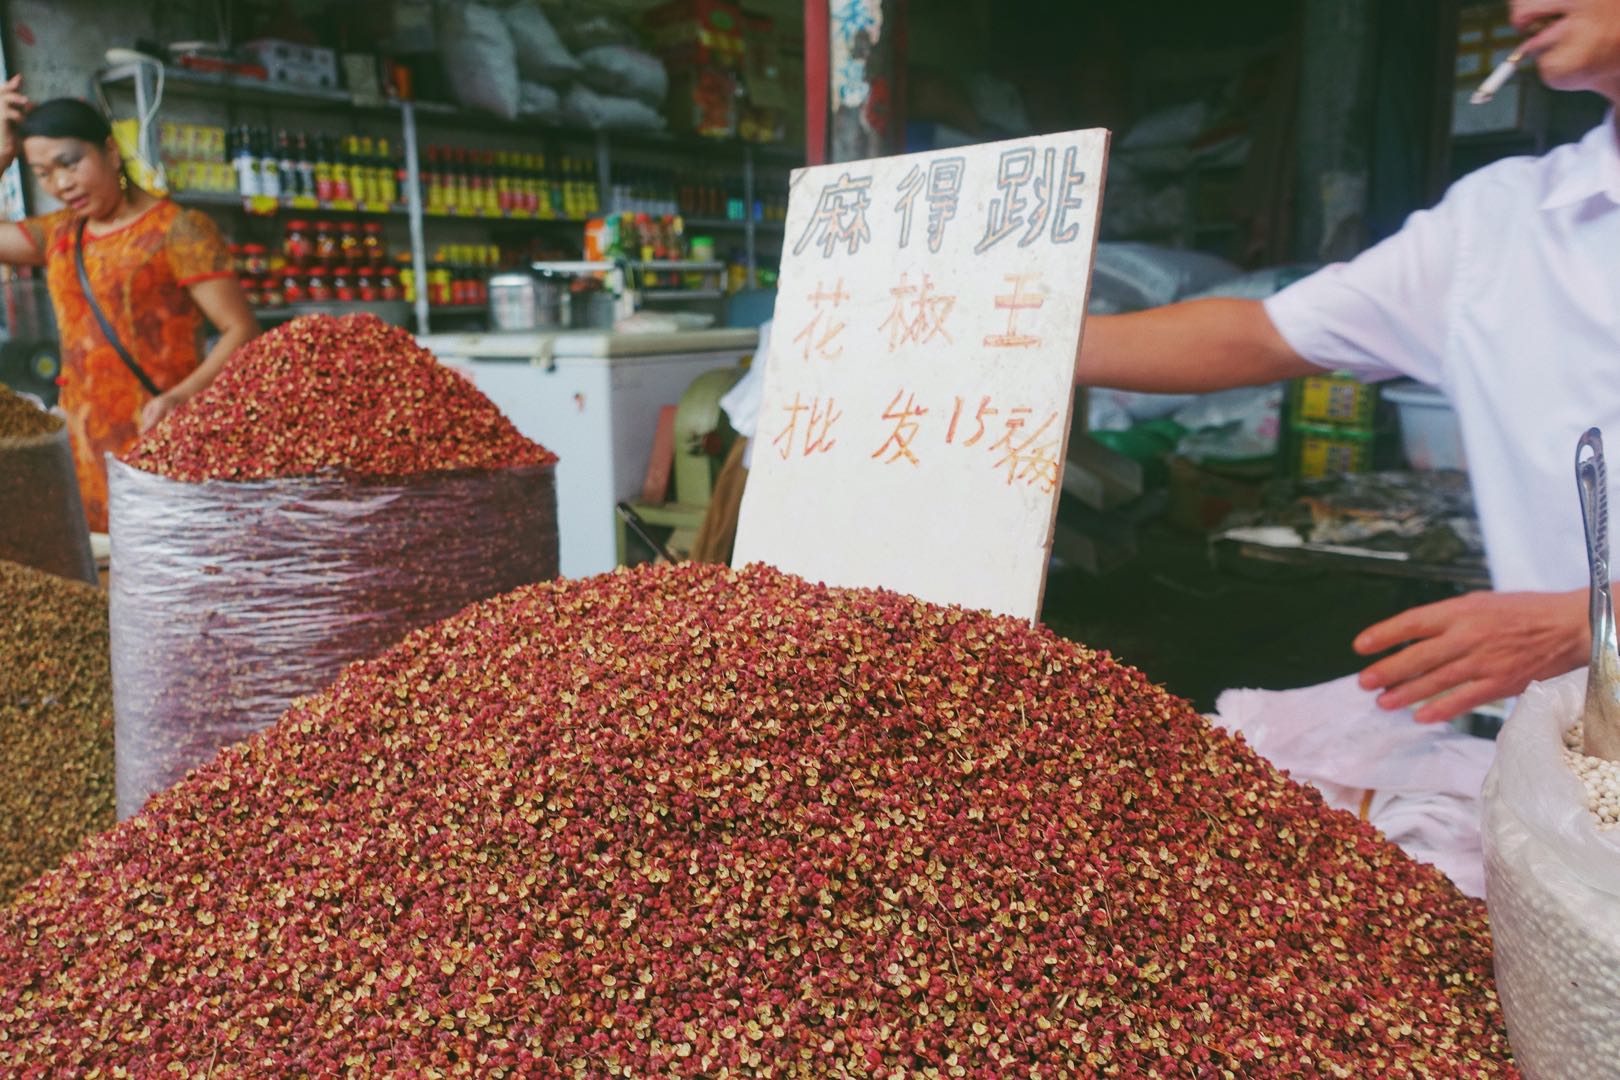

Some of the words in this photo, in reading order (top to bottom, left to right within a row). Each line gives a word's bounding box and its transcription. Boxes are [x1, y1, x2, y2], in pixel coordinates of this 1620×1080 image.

[793, 146, 1086, 257] 麻得跳
[793, 272, 1044, 362] 花椒王
